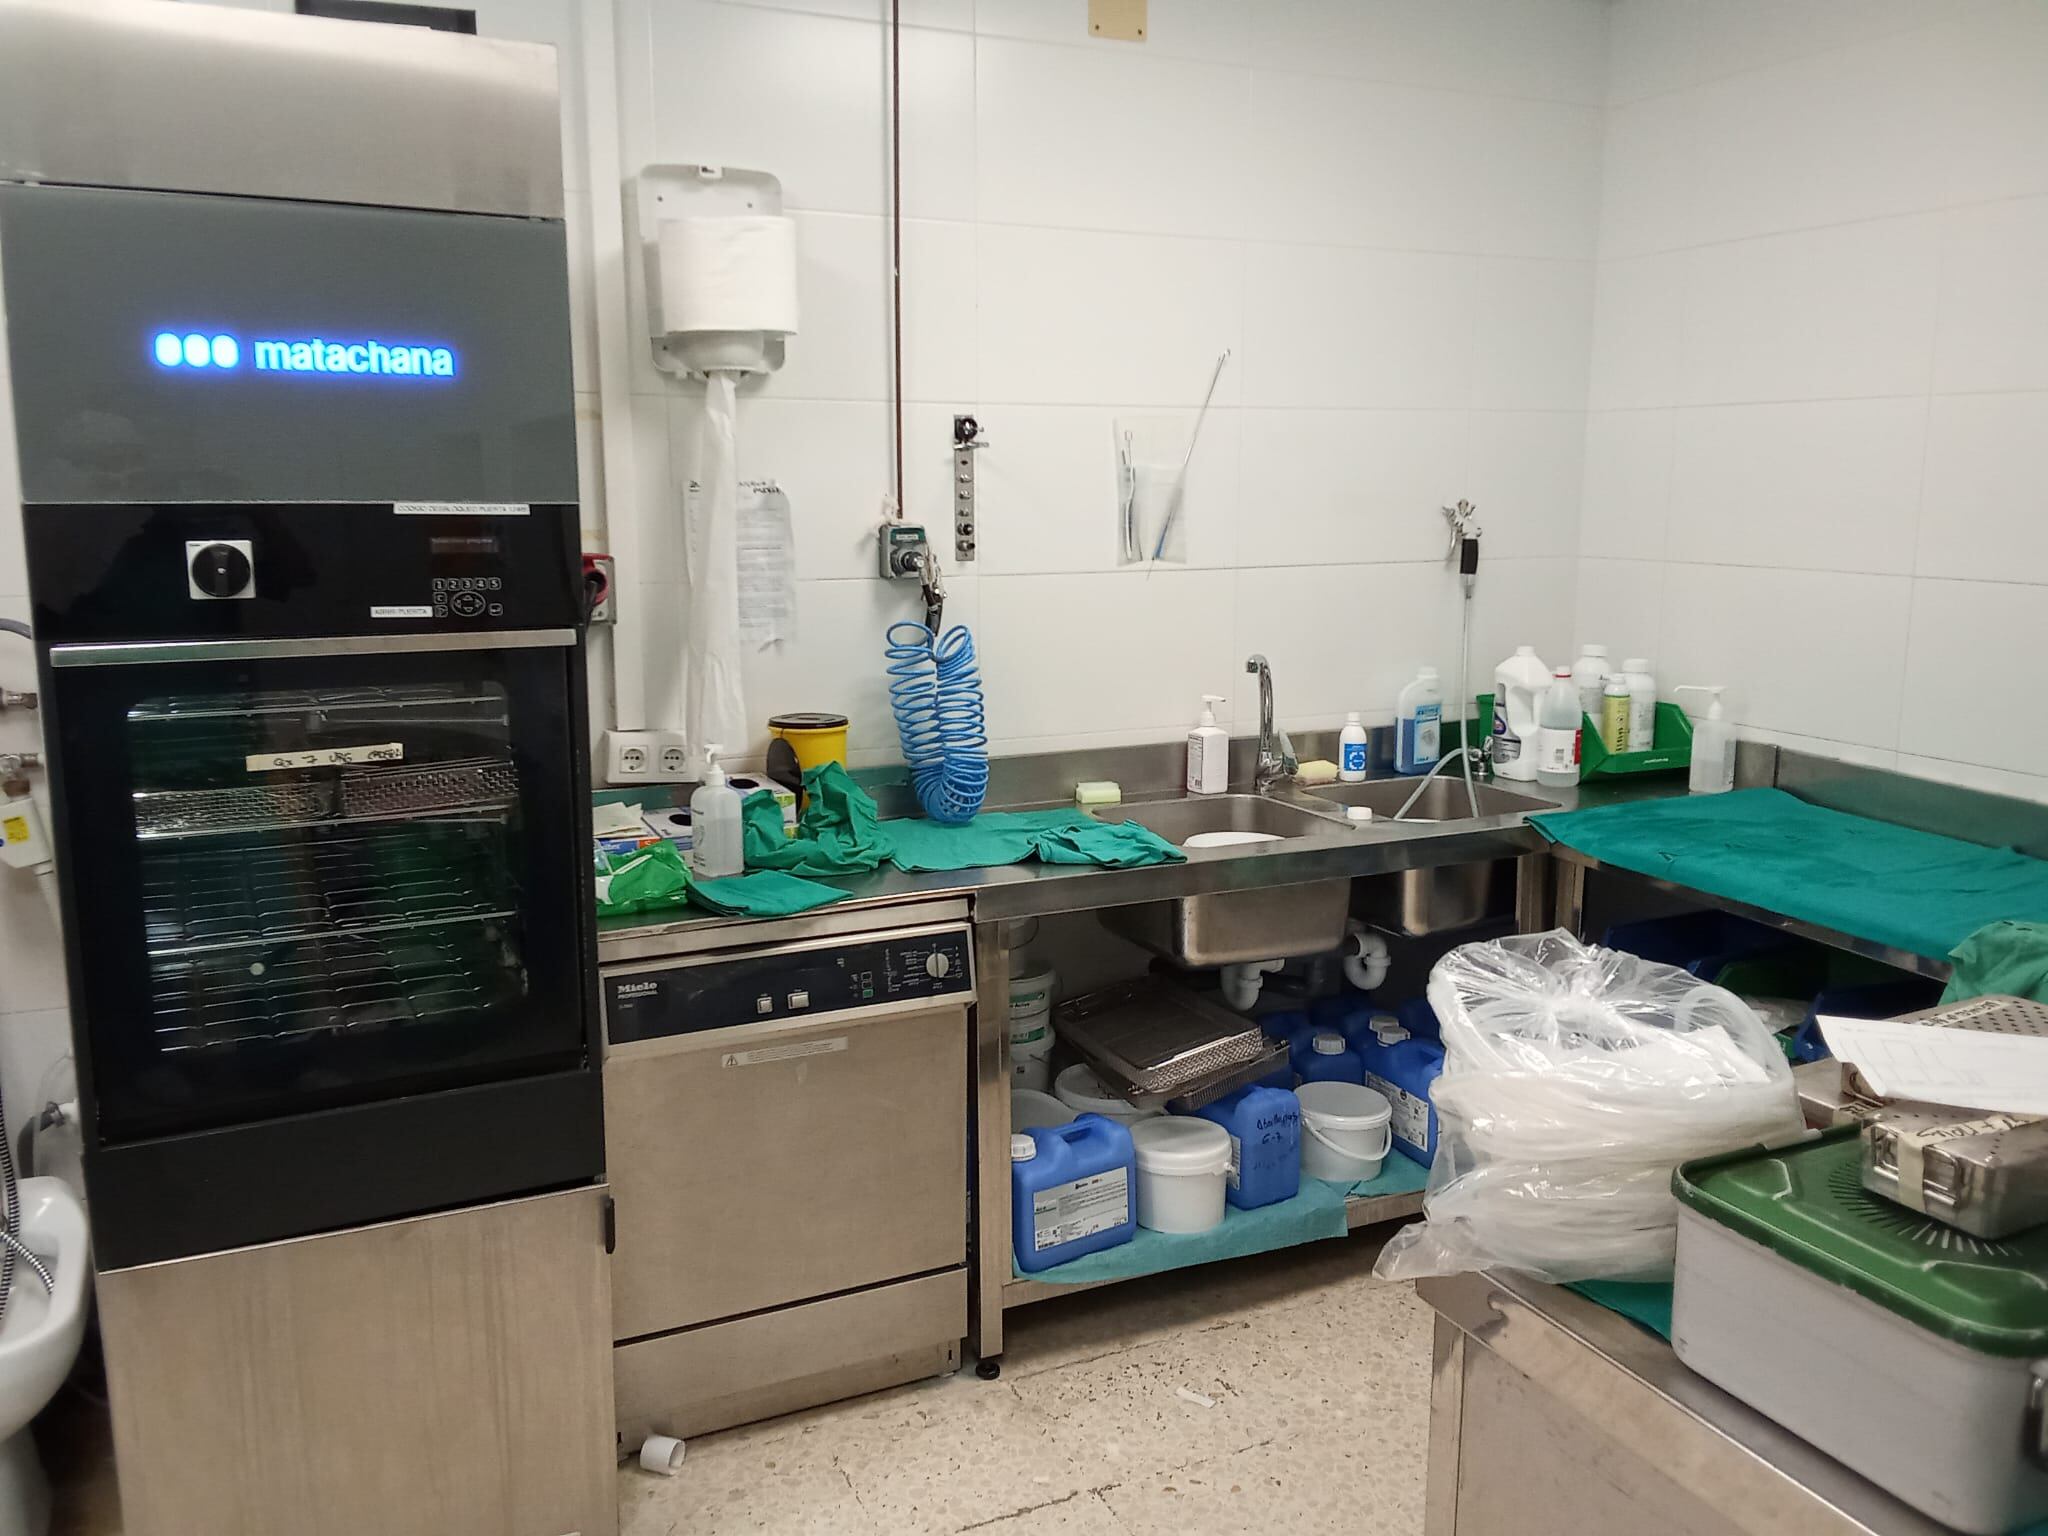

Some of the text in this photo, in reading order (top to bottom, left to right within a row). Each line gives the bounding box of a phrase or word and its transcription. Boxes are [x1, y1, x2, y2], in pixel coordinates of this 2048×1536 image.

[254, 337, 454, 376] matachana
[436, 580, 442, 589] 1
[449, 580, 457, 589] 2
[464, 580, 471, 588] 3
[491, 579, 498, 588] 5
[617, 982, 658, 994] Miele
